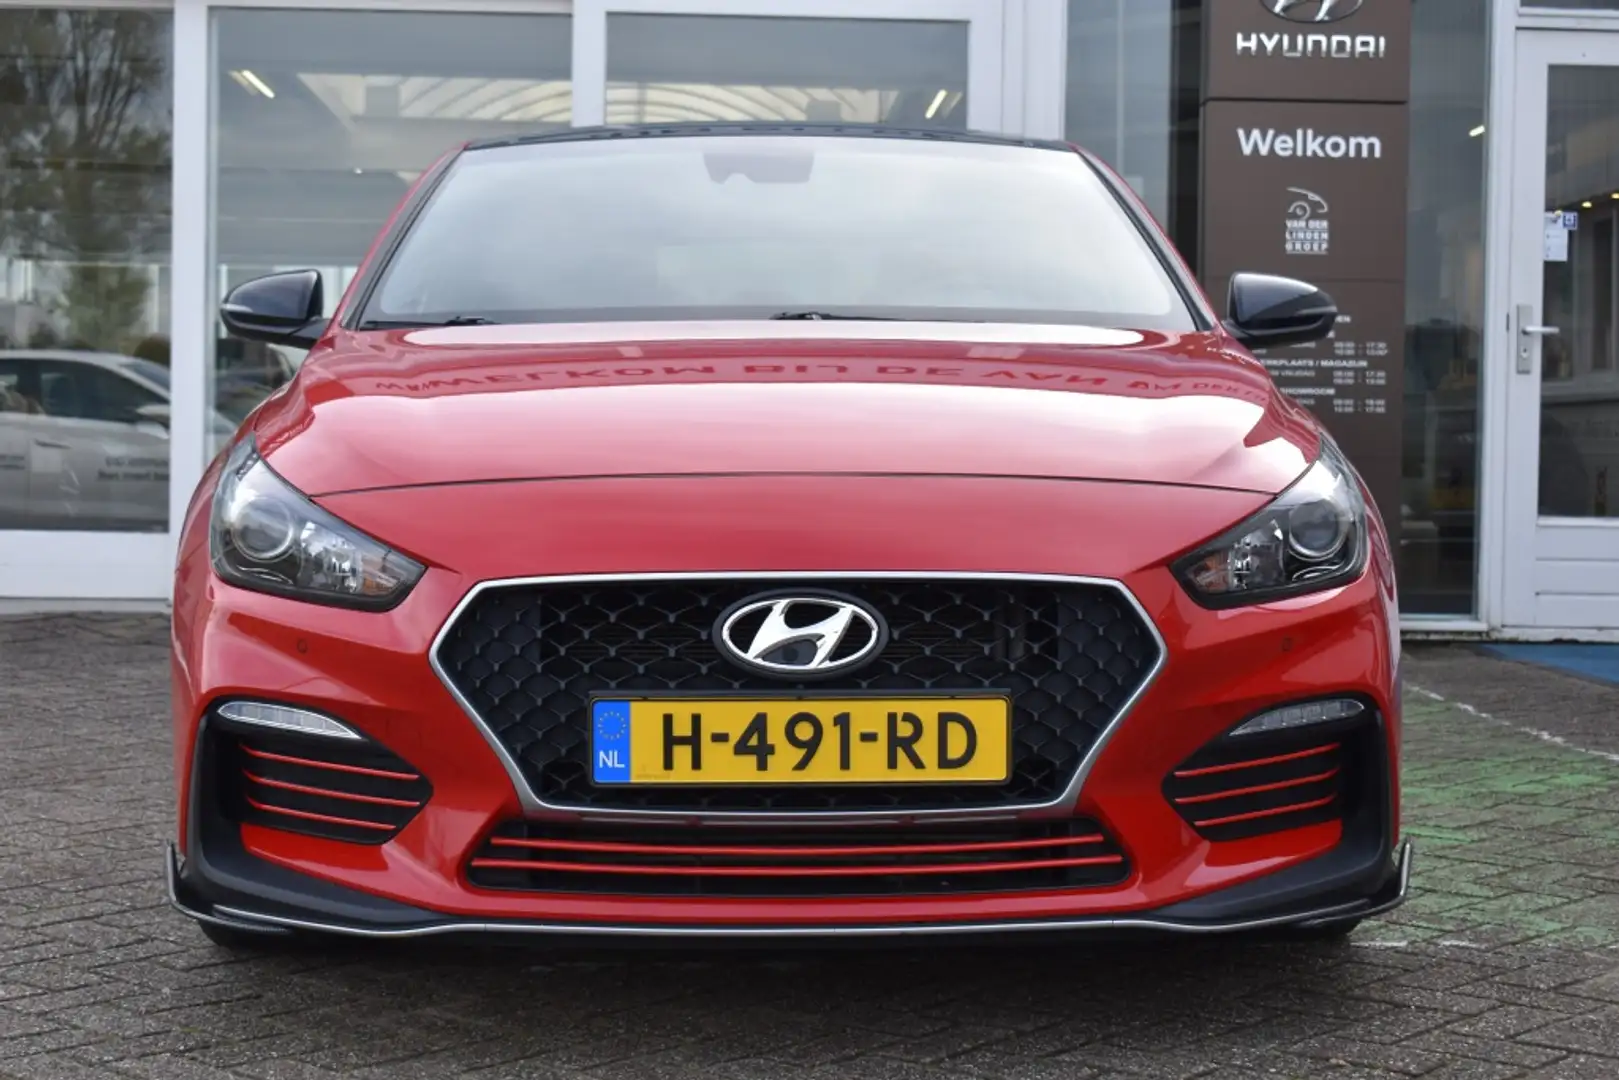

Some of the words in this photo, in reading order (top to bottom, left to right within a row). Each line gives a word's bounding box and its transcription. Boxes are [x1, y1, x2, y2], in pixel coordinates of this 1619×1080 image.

[1236, 32, 1386, 58] HYUNDAI
[1236, 127, 1382, 158] Welkom
[662, 711, 978, 771] H-491-RD
[599, 749, 625, 768] NL
